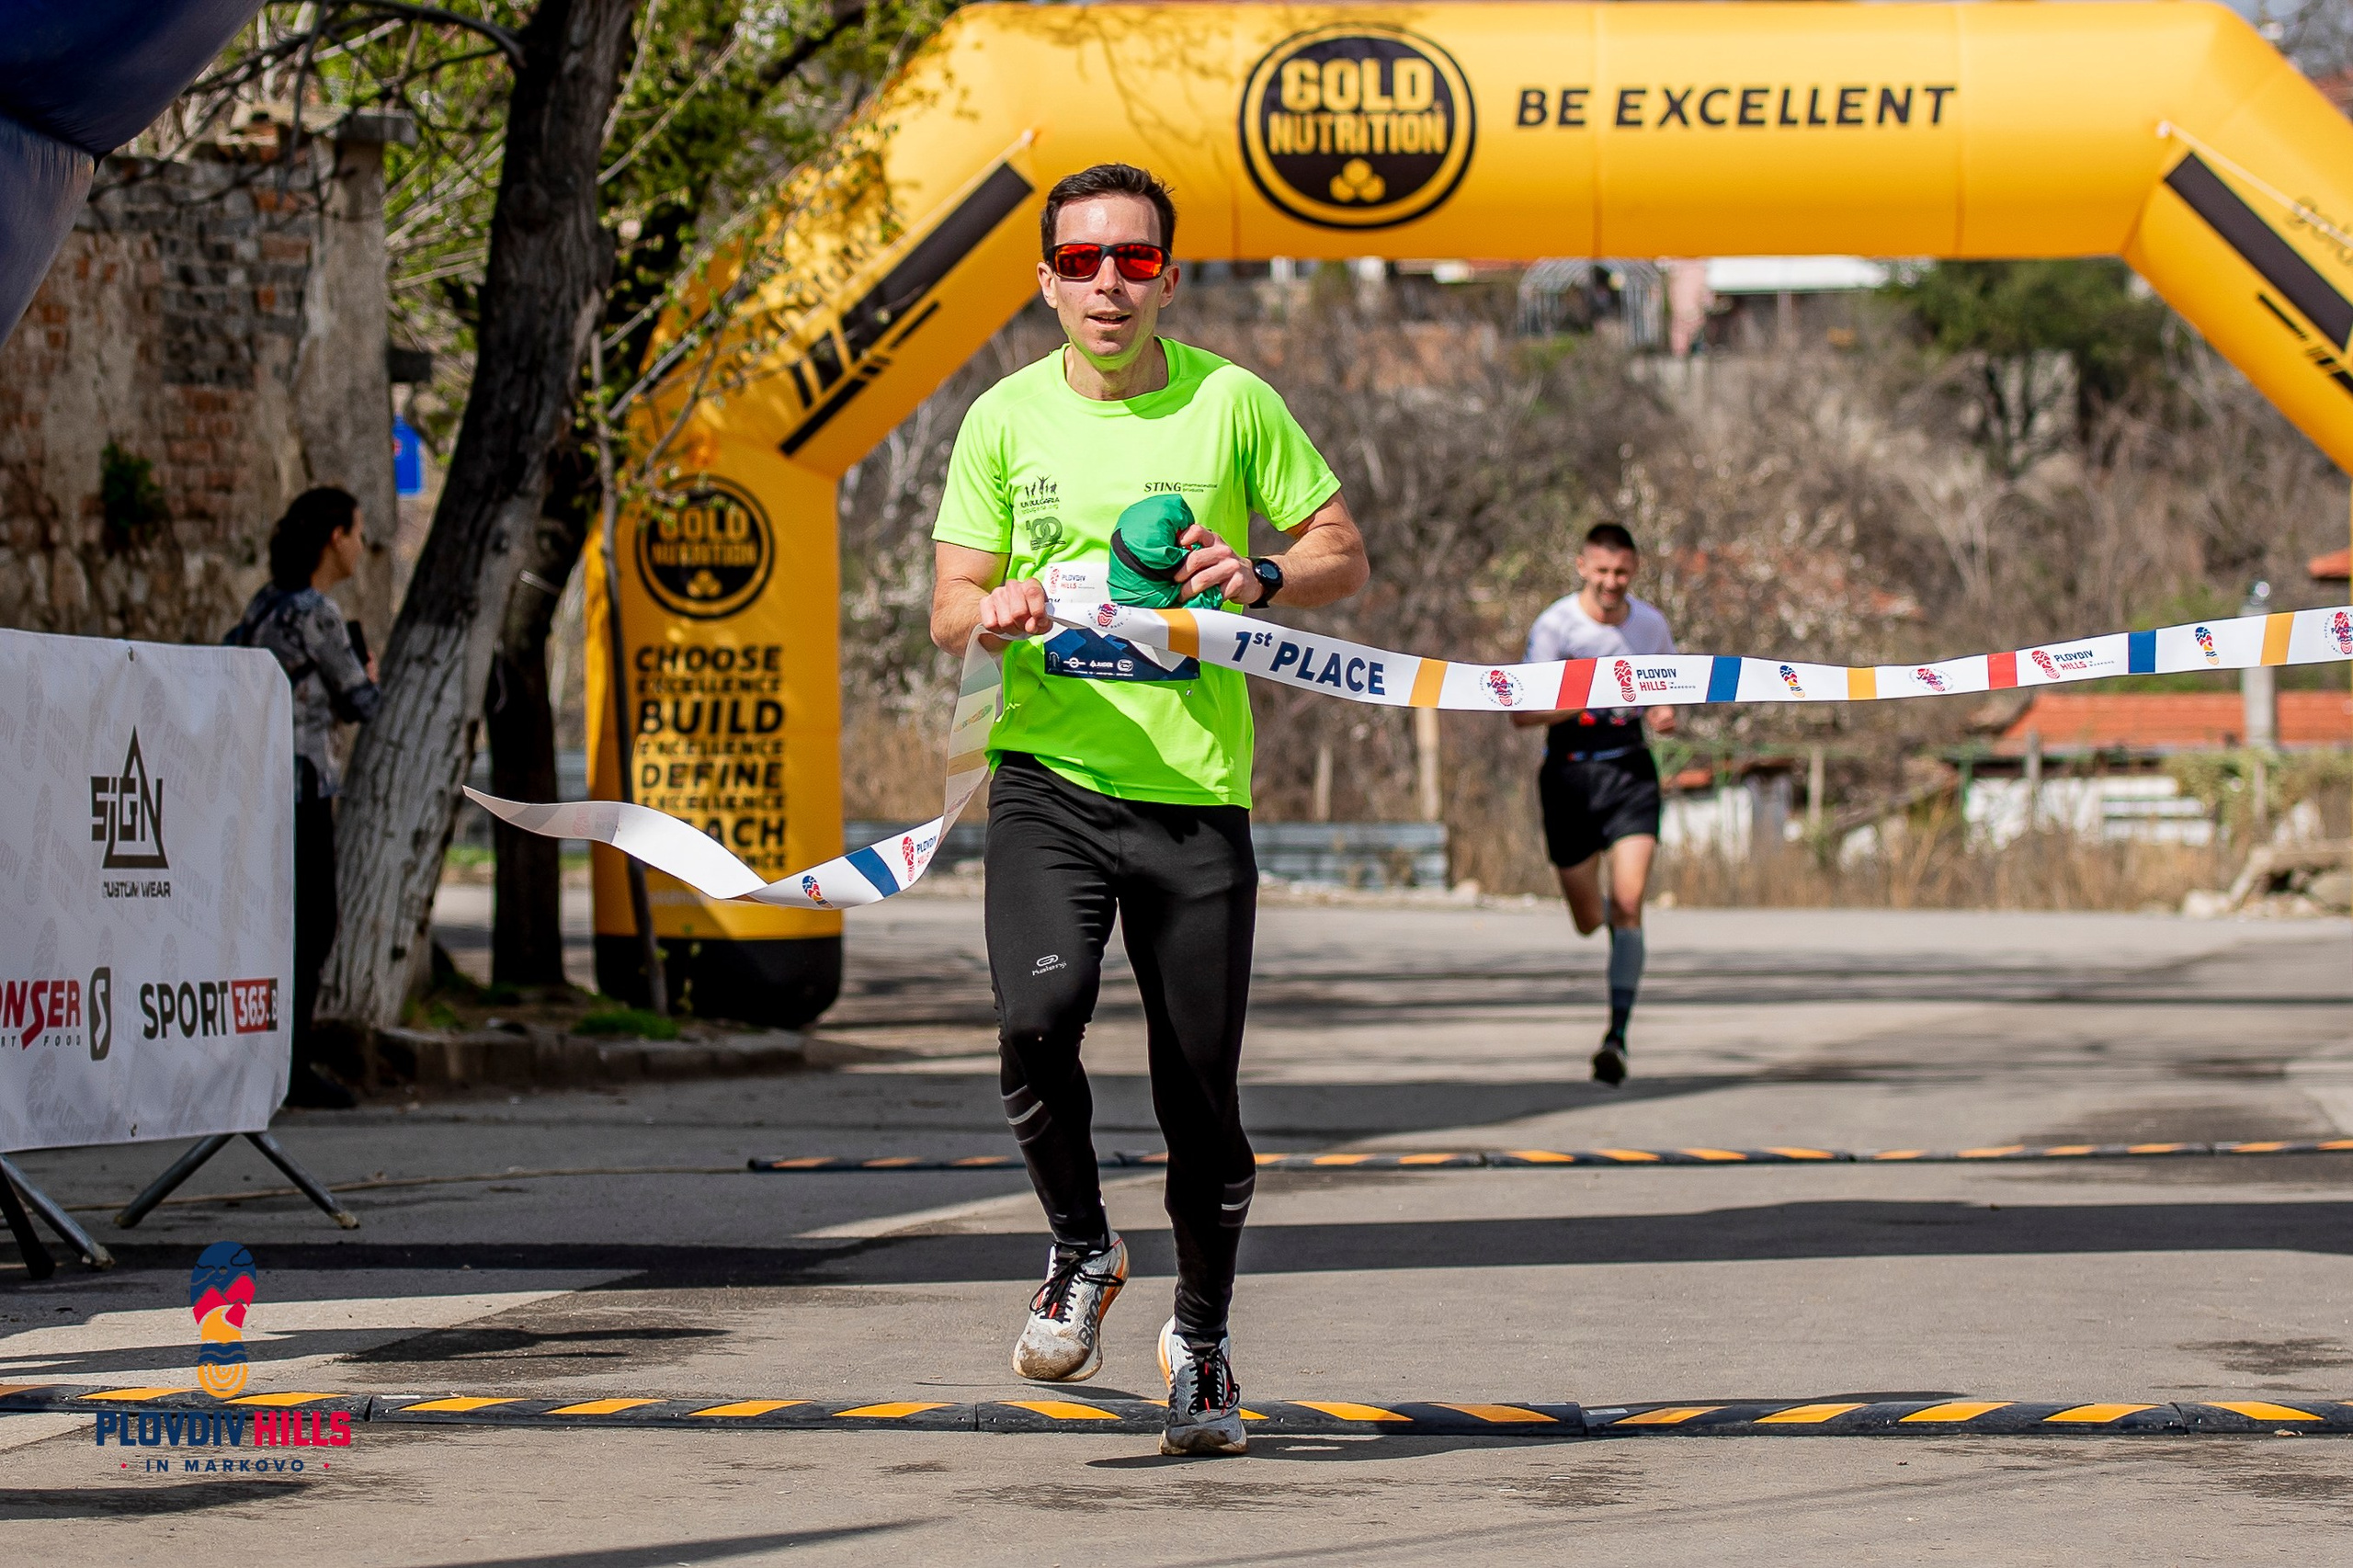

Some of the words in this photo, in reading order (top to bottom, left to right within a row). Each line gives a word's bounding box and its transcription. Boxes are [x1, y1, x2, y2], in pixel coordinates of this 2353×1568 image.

[1280, 58, 1435, 112] GOLD
[1517, 88, 1590, 127] BE
[1615, 88, 1956, 127] EXCELLENT
[1268, 111, 1448, 155] NUTRITION
[1144, 483, 1181, 493] STING
[636, 646, 782, 673] CHOOSE
[1231, 631, 1273, 663] 1st
[1268, 641, 1386, 696] PLACE
[2053, 650, 2094, 662] PLOVDIV
[2060, 661, 2087, 670] HILLS
[1636, 668, 1677, 679] PLOVDIV
[1639, 680, 1667, 691] HILLS
[640, 699, 785, 734] BUILD
[642, 763, 783, 789] DEFINE
[681, 817, 785, 846] ACH
[141, 881, 171, 898] WEAR
[0, 980, 81, 1051] NSER
[43, 1035, 81, 1047] FOOD
